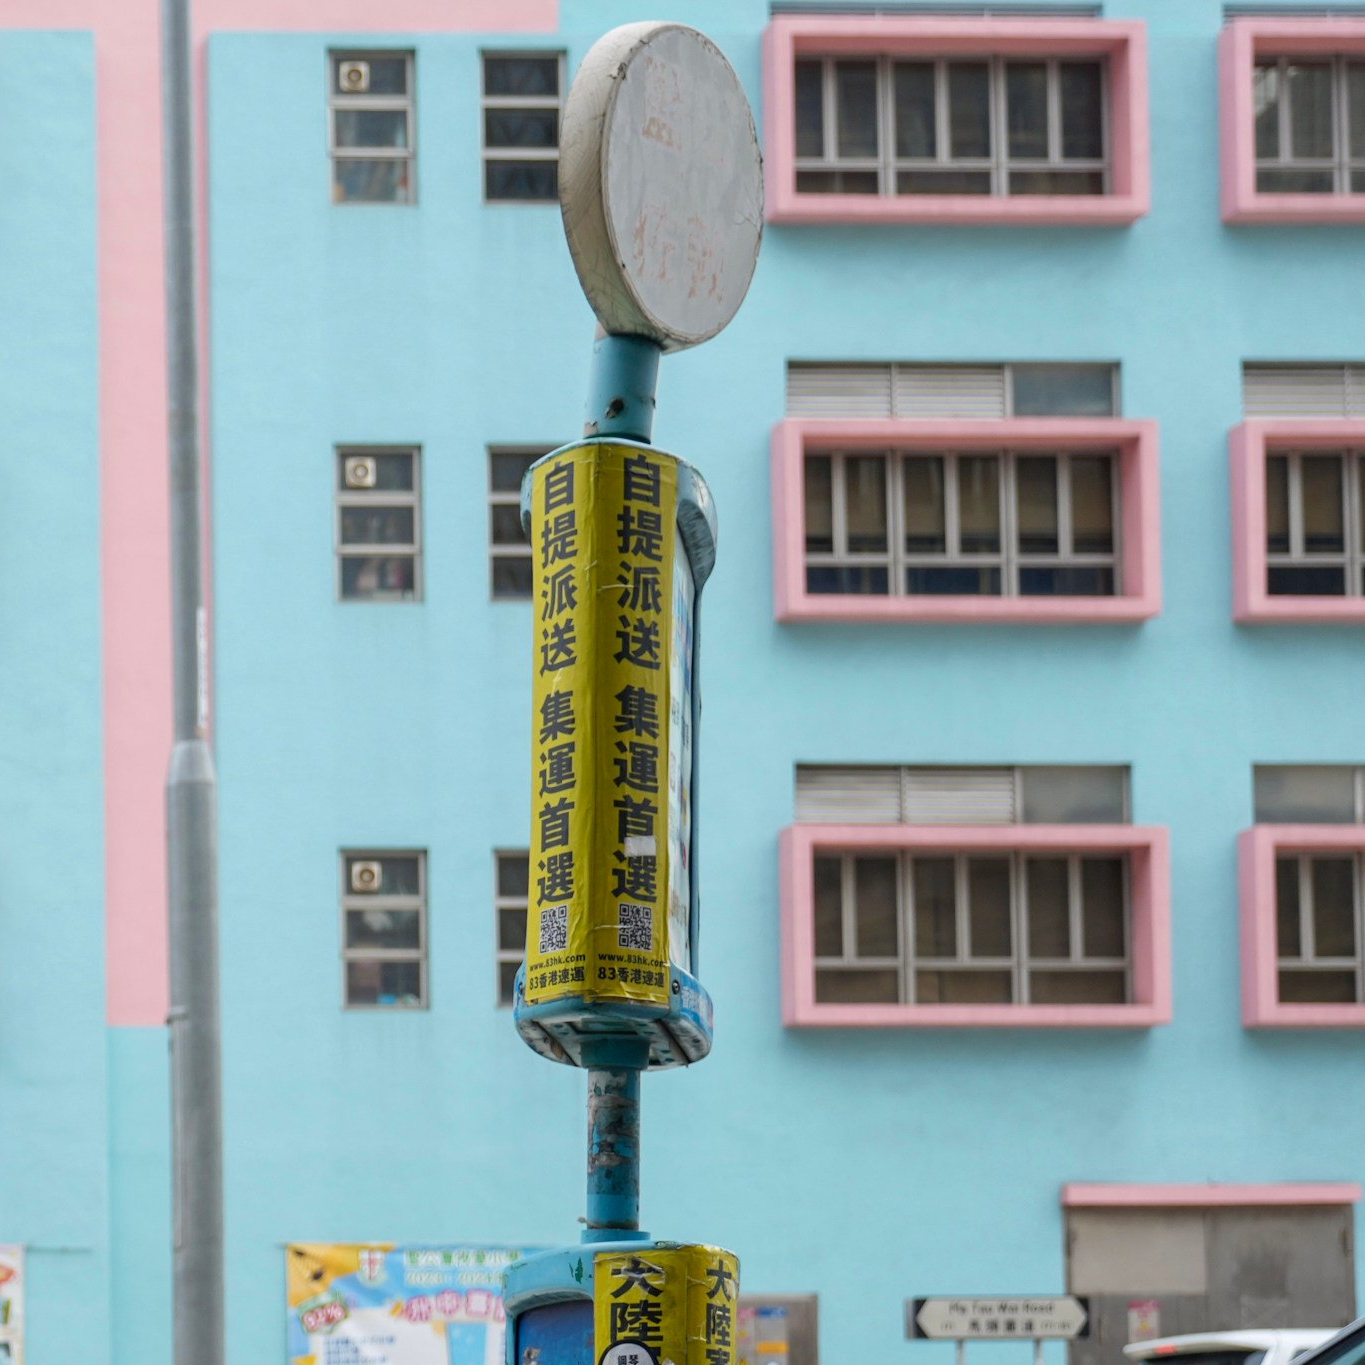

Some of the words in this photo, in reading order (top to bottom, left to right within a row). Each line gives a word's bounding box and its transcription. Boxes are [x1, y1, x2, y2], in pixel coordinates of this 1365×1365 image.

[540, 461, 578, 677] 自提派送
[613, 454, 663, 671] 自提派送
[537, 689, 577, 907] 集運首選
[529, 953, 586, 972] www.83hk.com
[529, 966, 585, 991] 83香港速運
[598, 966, 665, 988] 83香港速運
